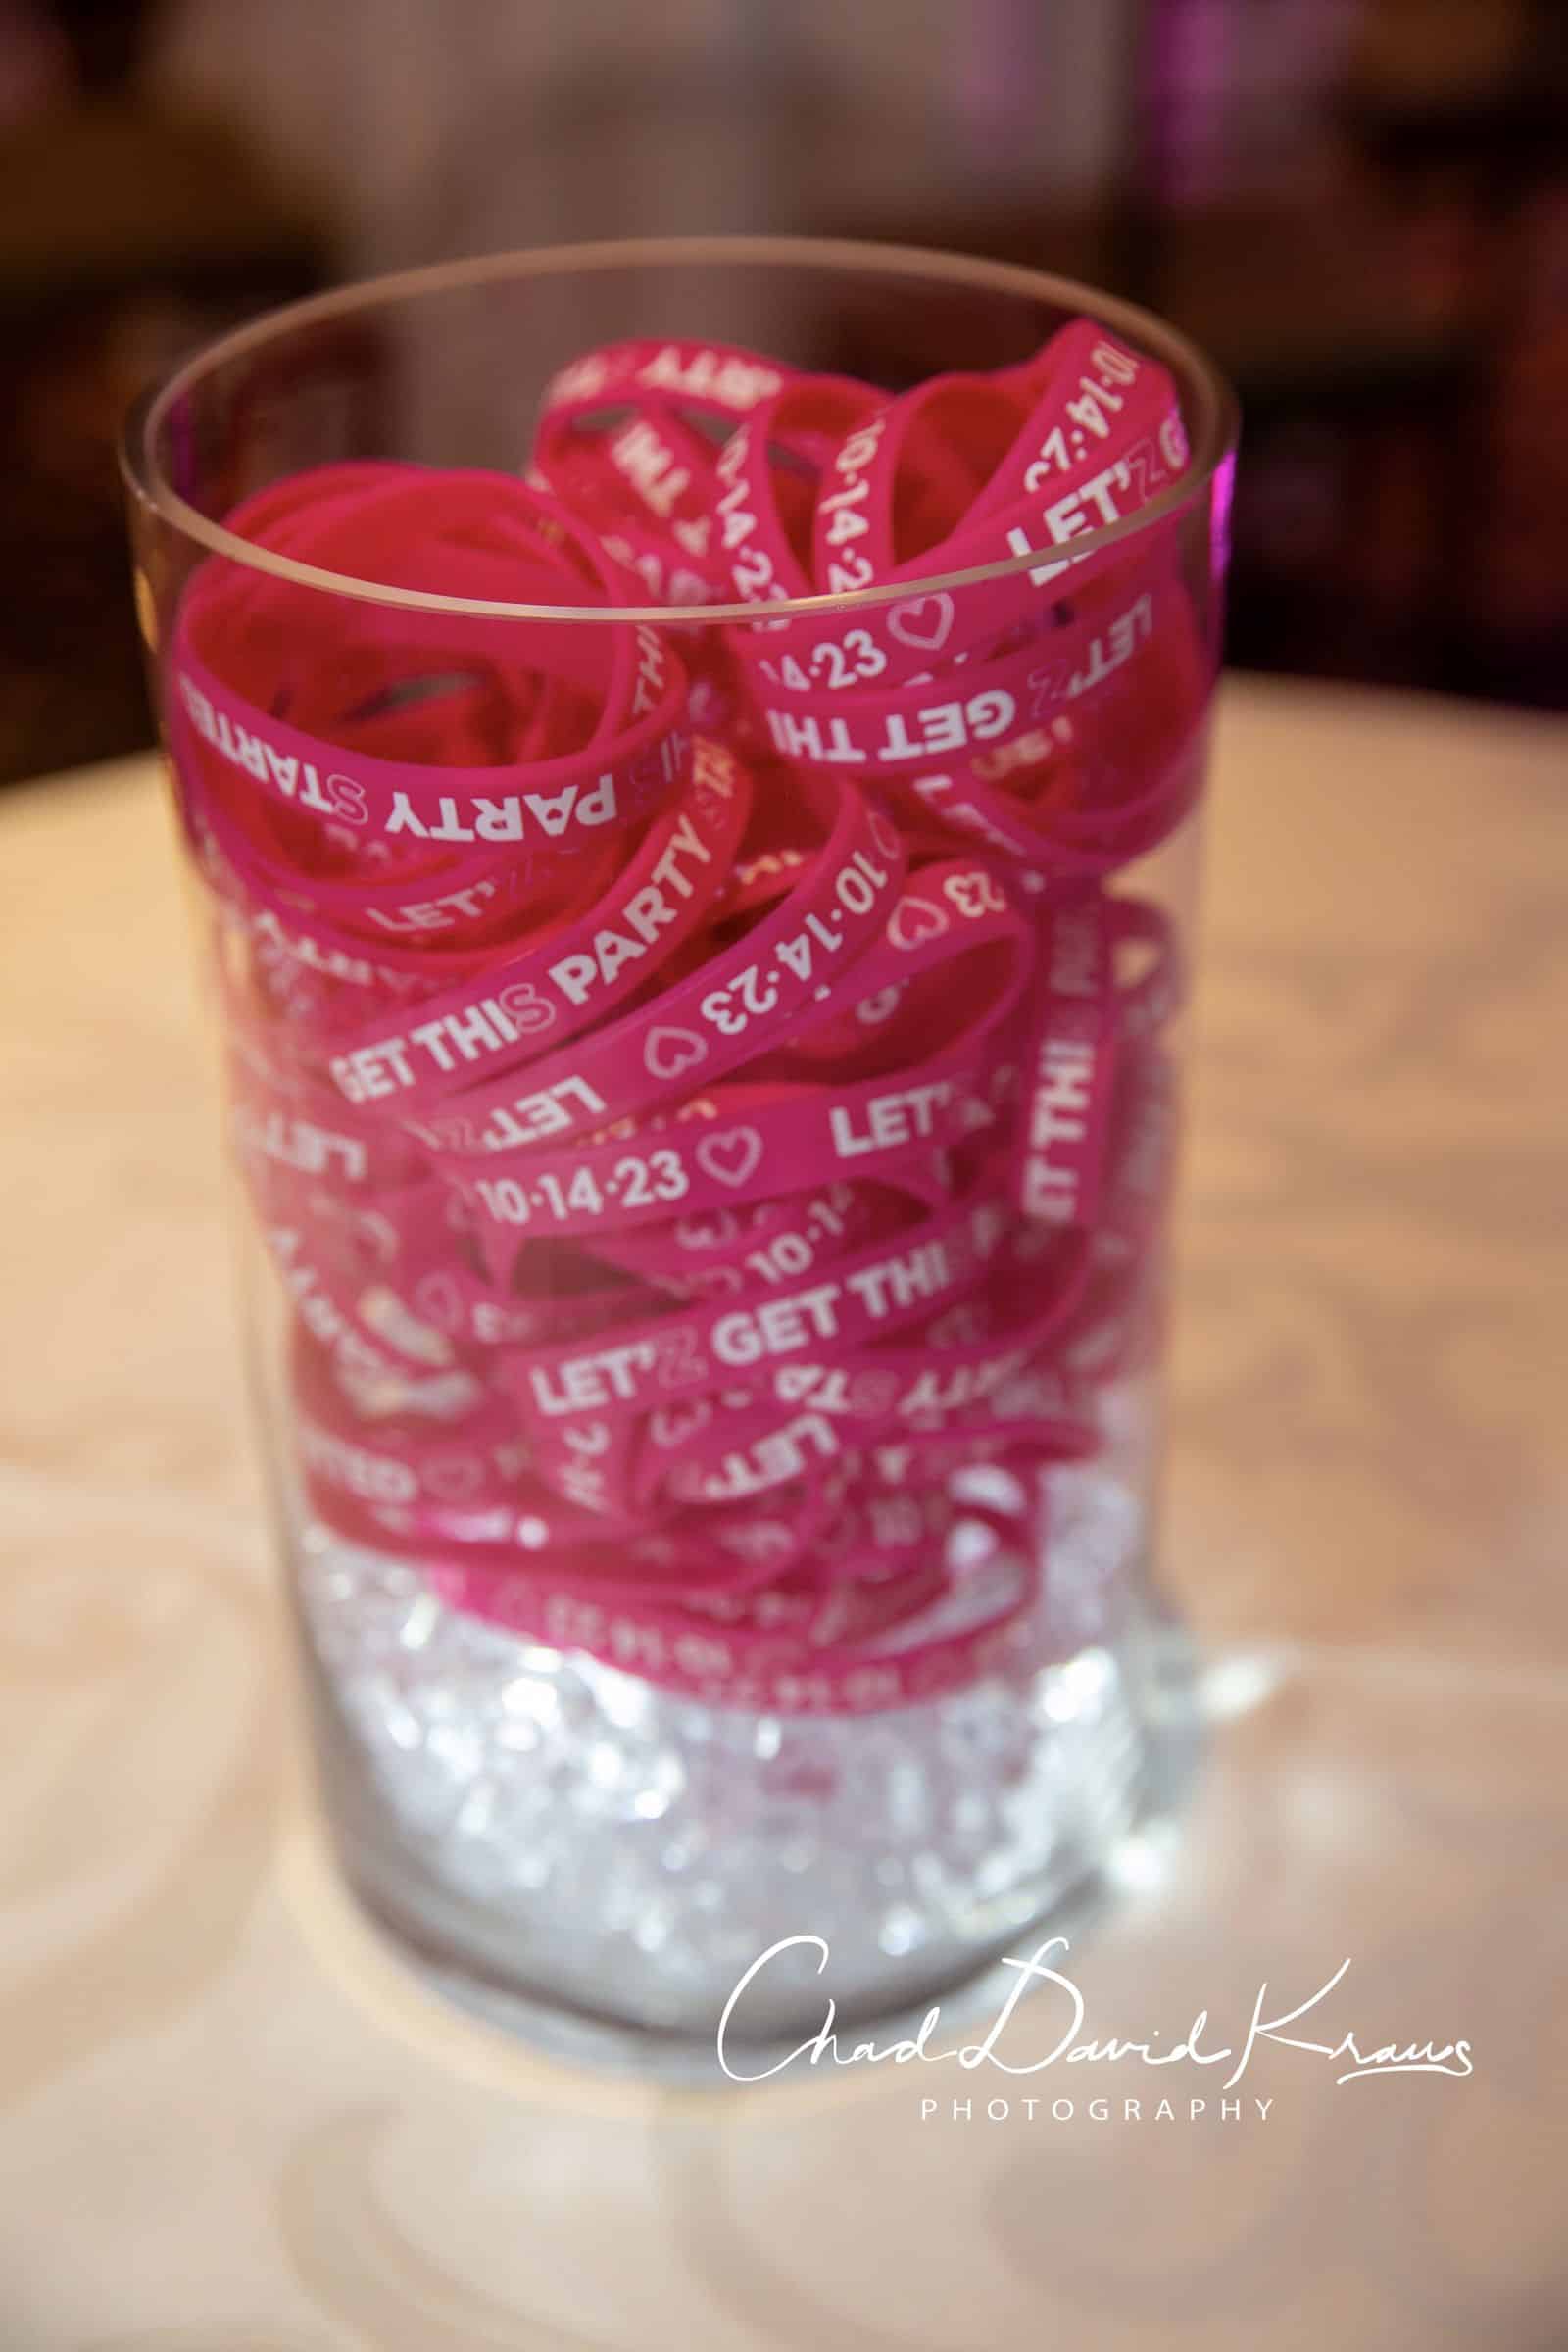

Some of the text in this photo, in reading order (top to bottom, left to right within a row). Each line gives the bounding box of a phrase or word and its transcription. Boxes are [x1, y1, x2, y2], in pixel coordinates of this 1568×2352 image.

[878, 690, 1016, 761] GET
[385, 774, 616, 842] PARTY
[412, 983, 556, 1071] THIS
[548, 815, 712, 1004] PARTY
[712, 1286, 840, 1364] GET
